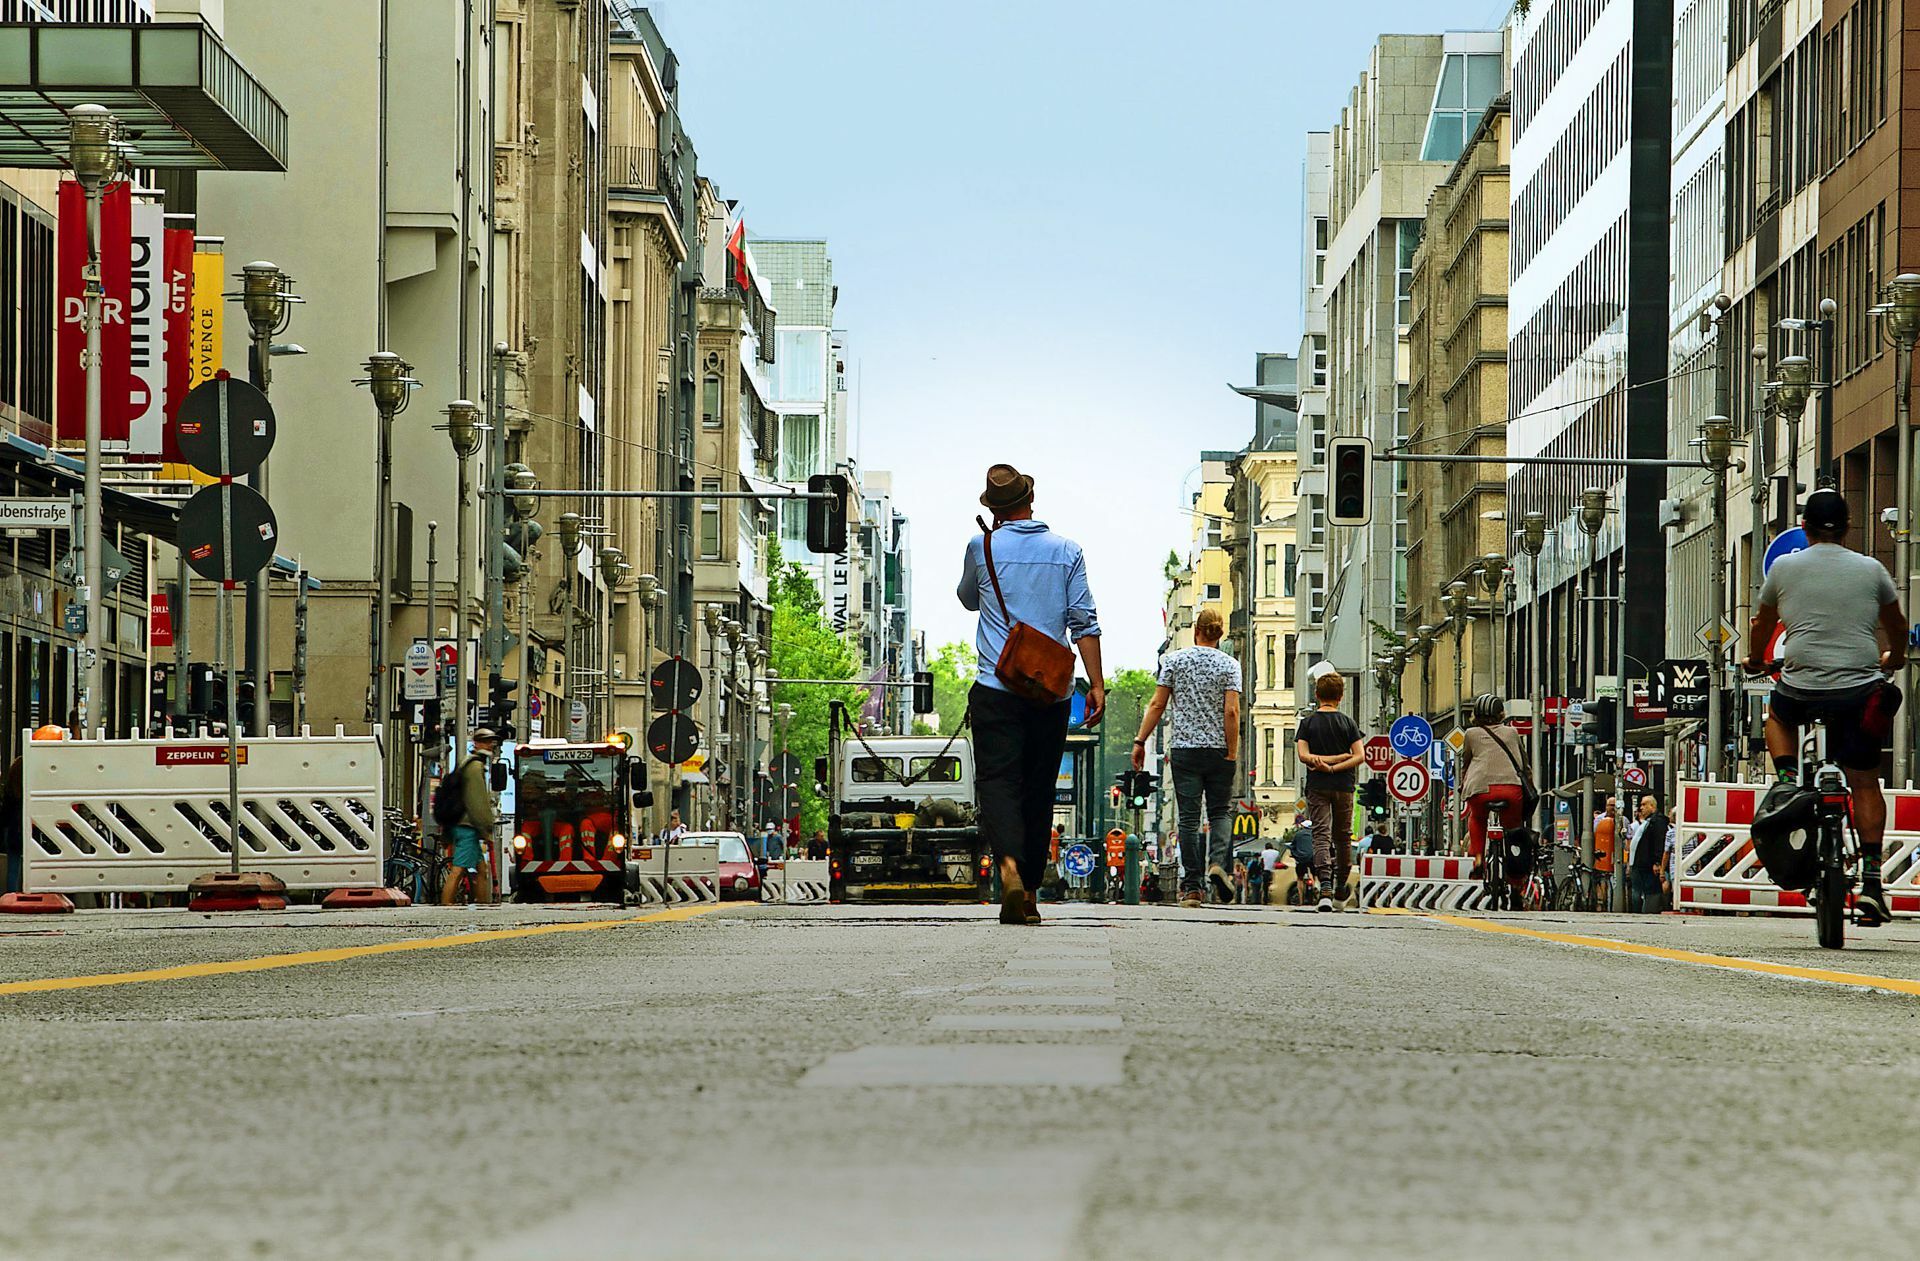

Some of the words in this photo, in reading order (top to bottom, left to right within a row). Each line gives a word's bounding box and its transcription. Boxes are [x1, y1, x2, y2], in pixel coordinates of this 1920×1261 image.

[171, 269, 187, 313] CITY
[64, 297, 125, 325] DR
[833, 570, 848, 586] LE
[833, 593, 847, 634] WALL
[415, 646, 426, 654] 30
[166, 751, 215, 760] ZEPPELIN
[576, 750, 592, 759] 252
[1397, 772, 1420, 790] 20
[1559, 800, 1569, 812] P
[953, 865, 966, 881] A
